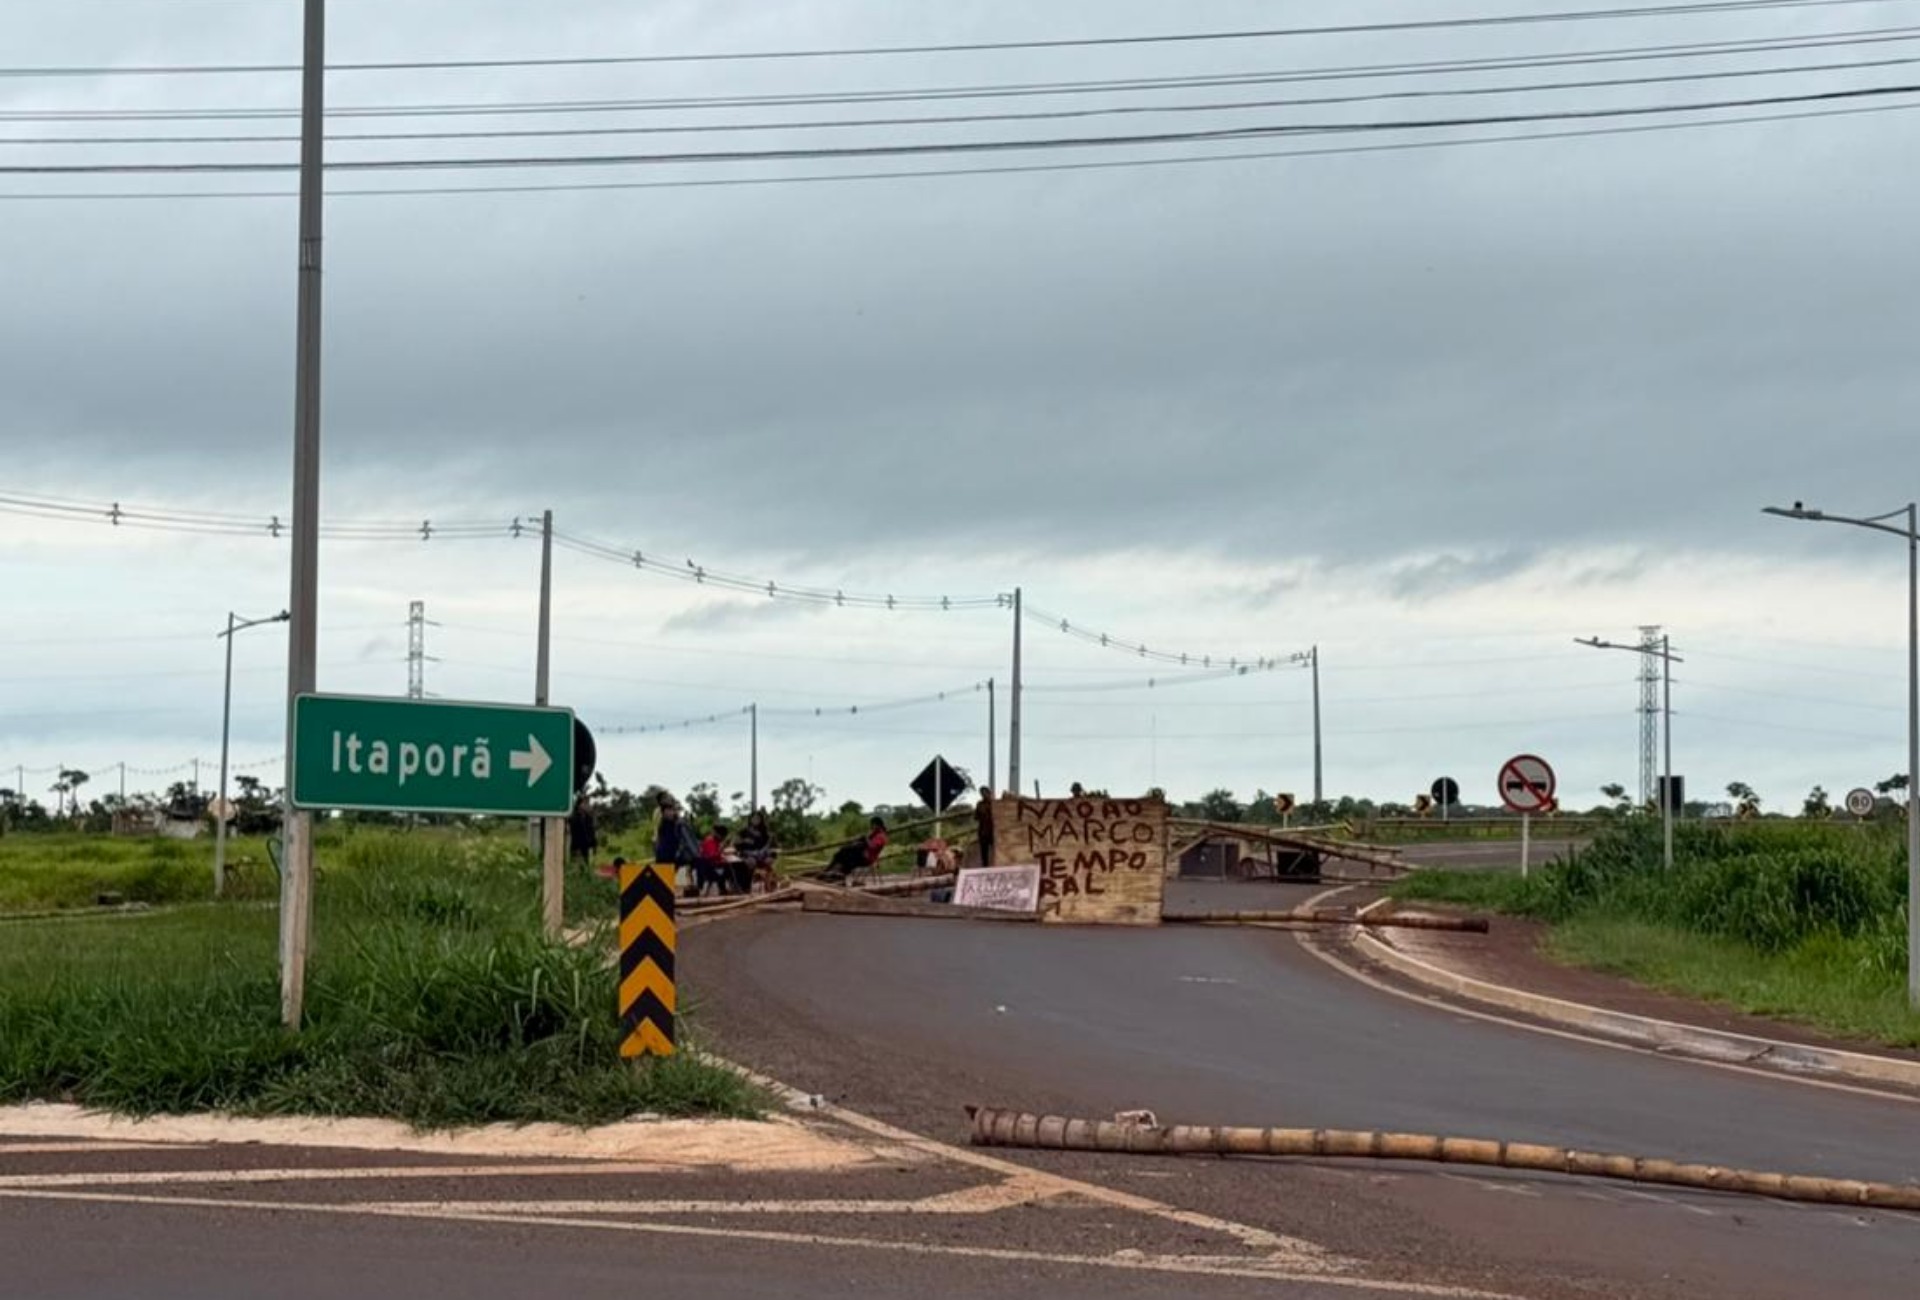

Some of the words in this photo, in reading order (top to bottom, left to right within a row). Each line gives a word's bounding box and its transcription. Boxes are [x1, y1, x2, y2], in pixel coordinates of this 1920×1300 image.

[332, 731, 492, 786] Itaporã
[1851, 796, 1870, 808] 80
[1028, 819, 1154, 852] MARCO
[1034, 849, 1147, 879] TEMPO
[1039, 873, 1105, 898] RAL
